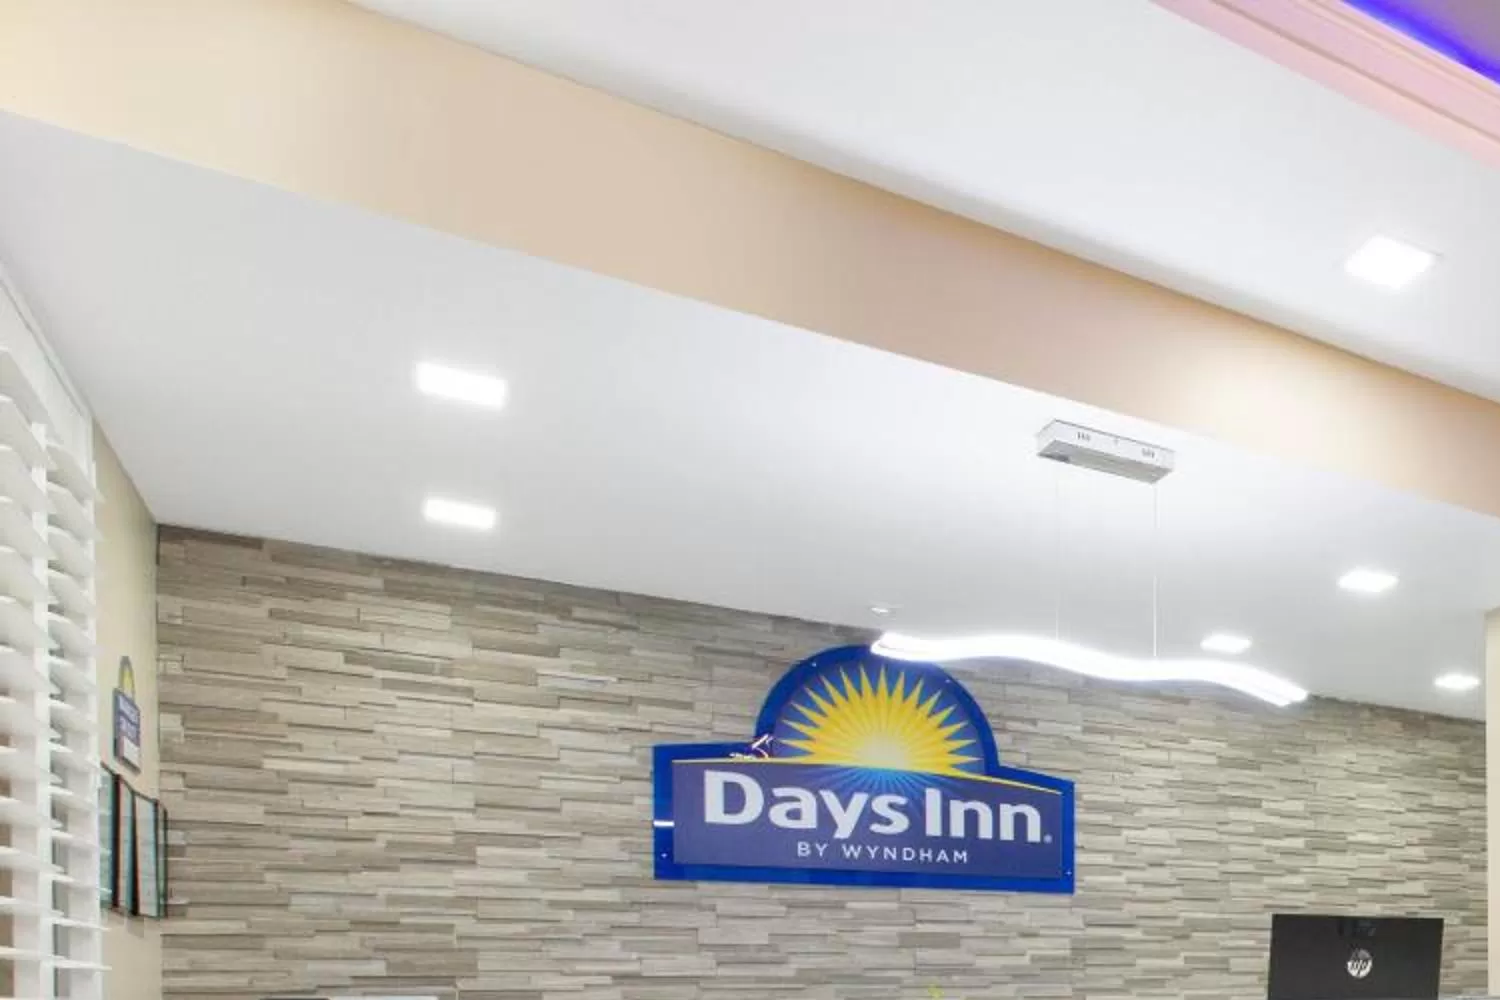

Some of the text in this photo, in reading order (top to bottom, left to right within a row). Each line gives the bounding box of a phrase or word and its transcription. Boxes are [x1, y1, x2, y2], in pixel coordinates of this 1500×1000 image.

[704, 770, 1042, 844] Days Inn
[797, 841, 968, 864] BY WYNDHAM
